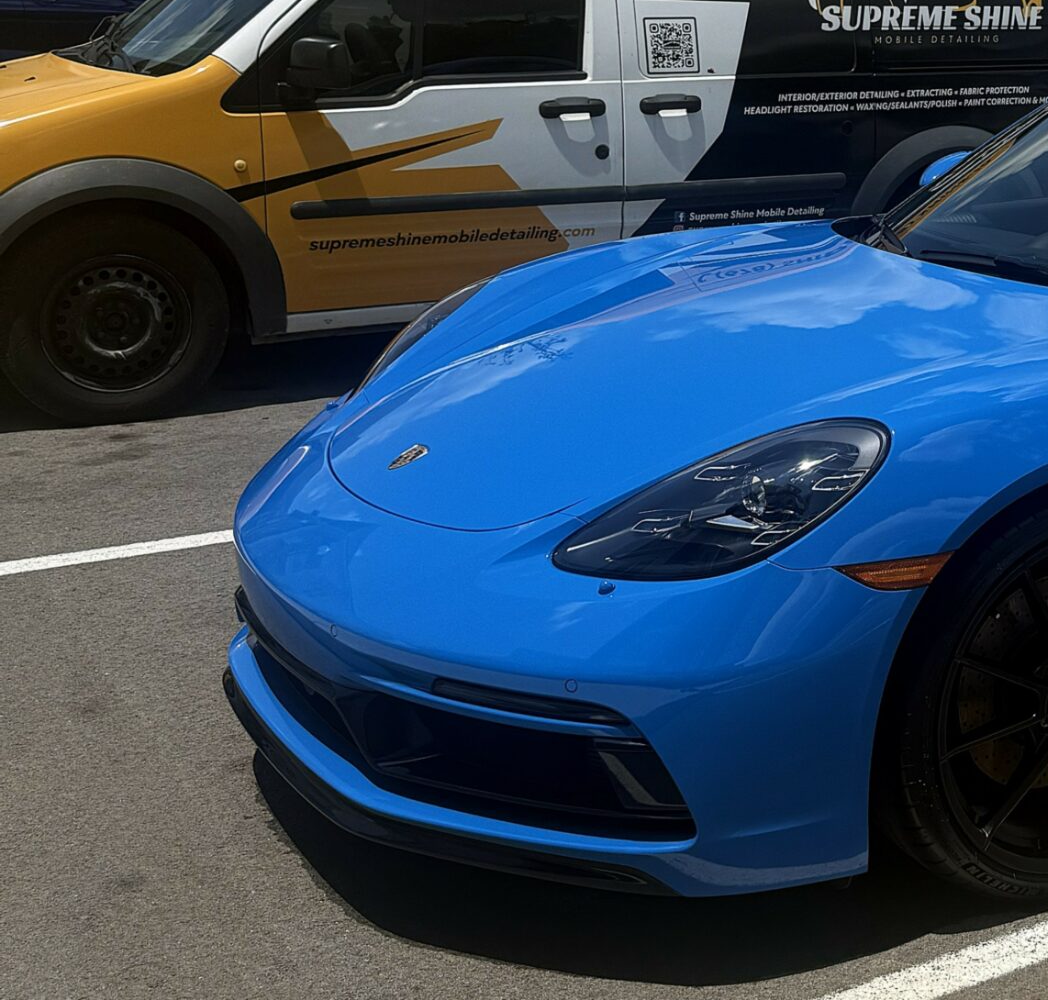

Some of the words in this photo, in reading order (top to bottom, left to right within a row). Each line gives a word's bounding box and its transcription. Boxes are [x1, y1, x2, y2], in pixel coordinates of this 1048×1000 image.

[821, 4, 957, 31] SUPREME
[963, 5, 1044, 31] SHINE
[874, 35, 922, 44] MOBILE
[931, 34, 999, 44] DETAILING
[778, 92, 858, 102] INTERIOR/EXTERIOR
[859, 90, 899, 99] DETAILING
[906, 88, 953, 97] EXTRACTING
[960, 87, 985, 95] FABRIC
[986, 86, 1030, 95] PROTECTION
[743, 105, 792, 115] HEADLIGHT
[793, 103, 849, 113] RESTORATION
[963, 98, 985, 107] PAINT
[986, 97, 1031, 106] CORRECTION
[1032, 96, 1039, 104] &
[689, 212, 728, 222] Supreme
[730, 210, 754, 219] Shine
[756, 208, 785, 217] Mobile
[787, 206, 825, 216] Detailing
[309, 226, 595, 253] supremeshinemobiledetailing.com
